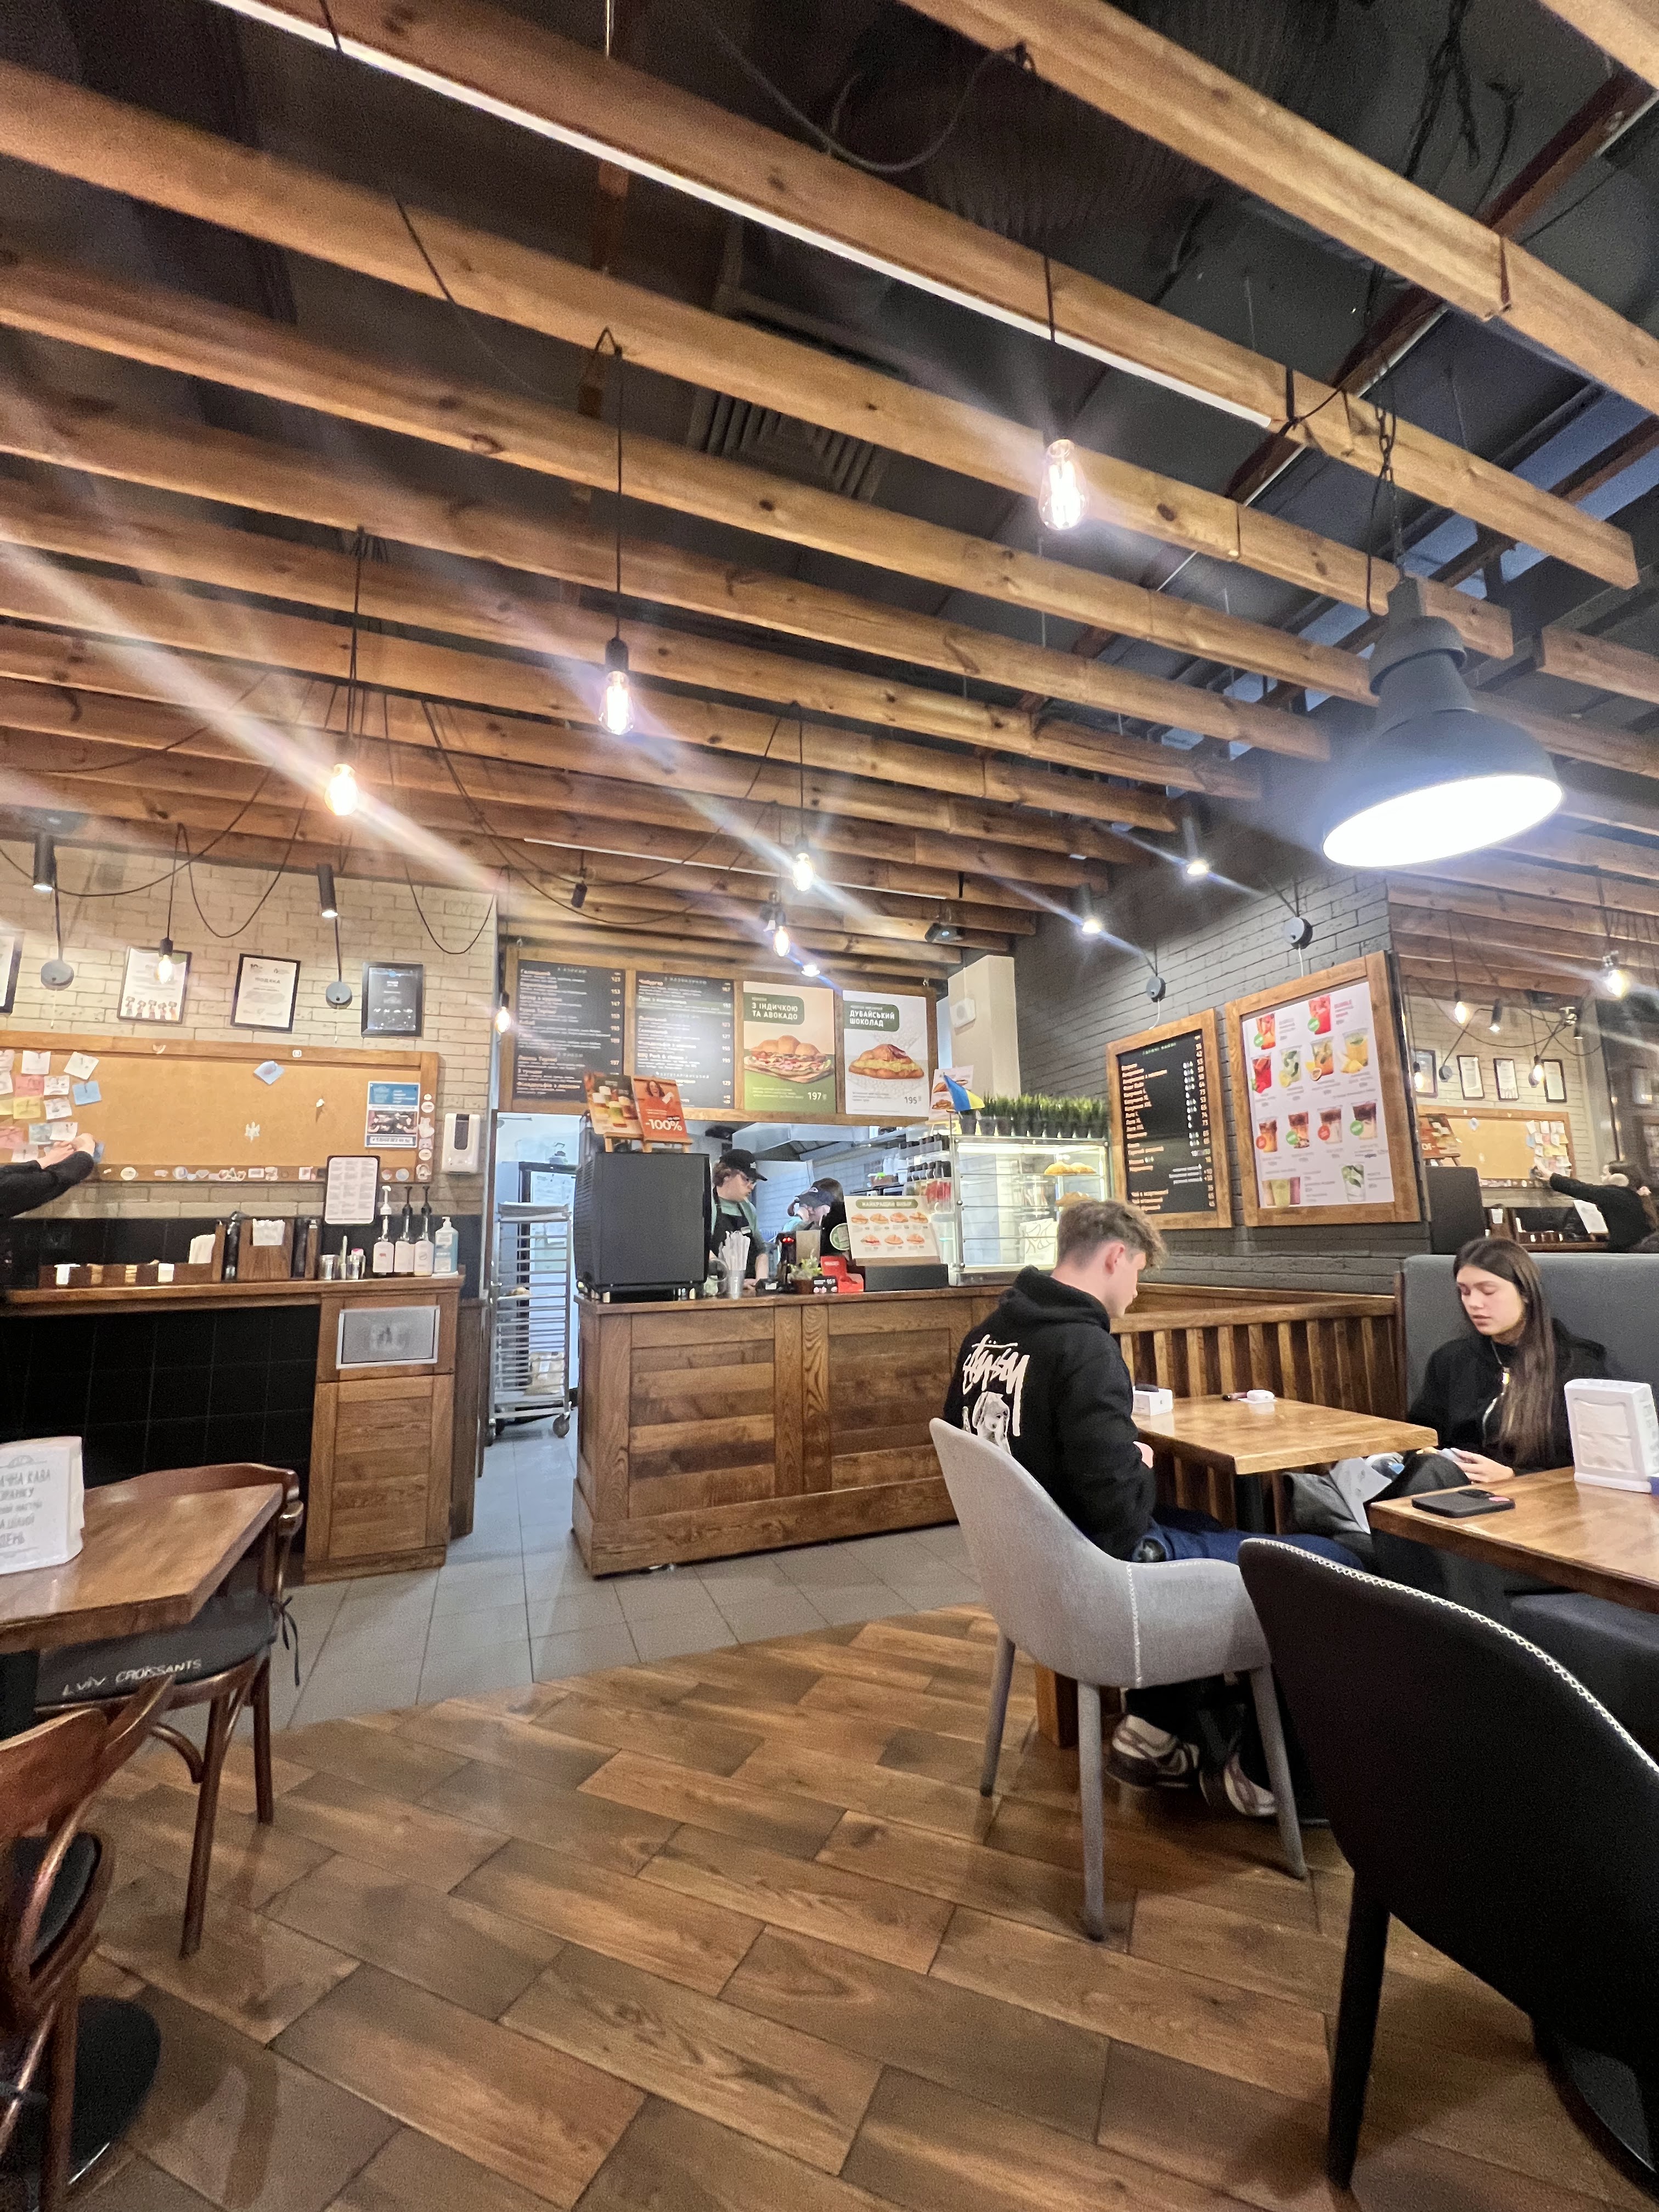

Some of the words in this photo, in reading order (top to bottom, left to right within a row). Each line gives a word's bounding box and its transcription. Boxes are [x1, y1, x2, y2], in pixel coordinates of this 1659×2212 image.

[759, 1003, 798, 1012] ІНДИЧКОЮ
[764, 1012, 798, 1020] АВОКАДО
[850, 1009, 895, 1020] ДУБАЙСЬКИЙ
[850, 1018, 884, 1027] ШОКОЛАД
[808, 1092, 822, 1101] 197
[645, 1119, 683, 1131] -100%
